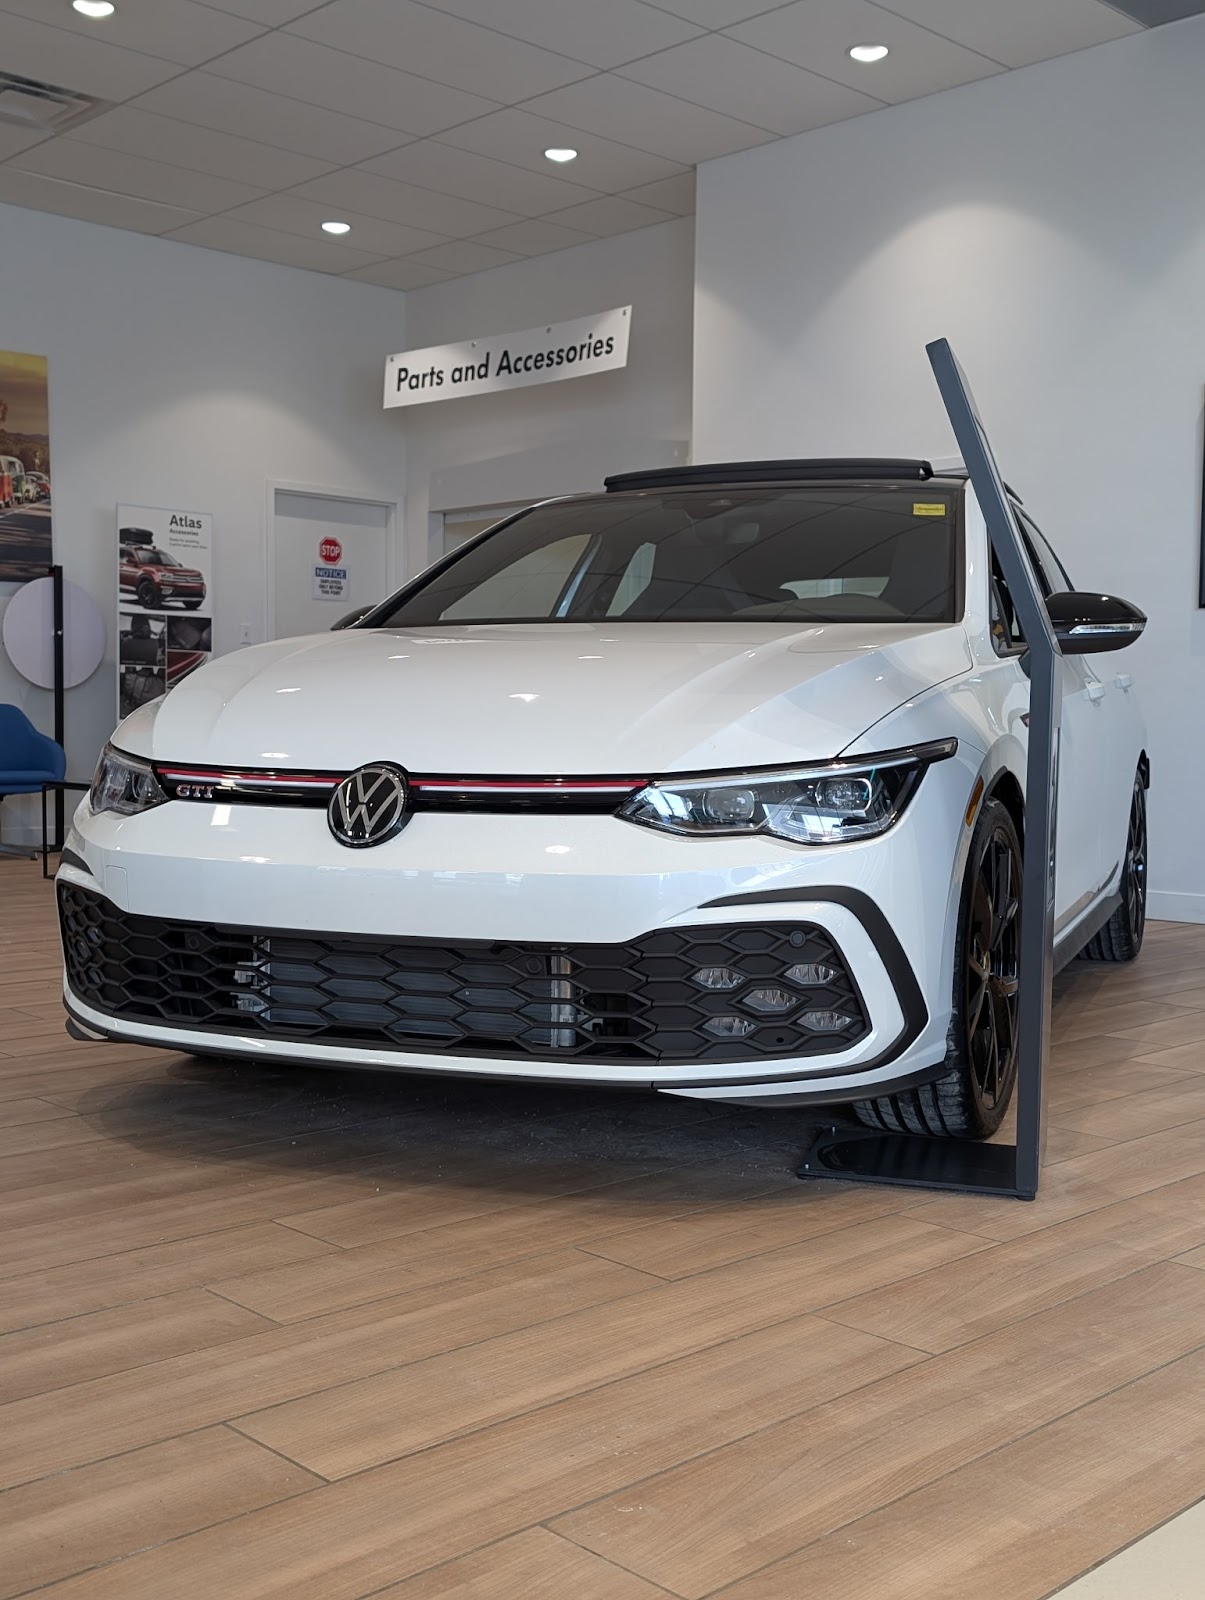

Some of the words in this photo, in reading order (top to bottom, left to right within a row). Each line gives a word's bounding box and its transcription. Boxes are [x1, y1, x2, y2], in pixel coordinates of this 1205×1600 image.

[396, 366, 445, 393] Parts
[451, 351, 491, 384] and
[496, 332, 615, 378] Accessories
[170, 514, 202, 529] Atlas
[321, 545, 340, 557] STOP
[317, 569, 345, 578] NOTICE
[176, 784, 214, 798] GTI
